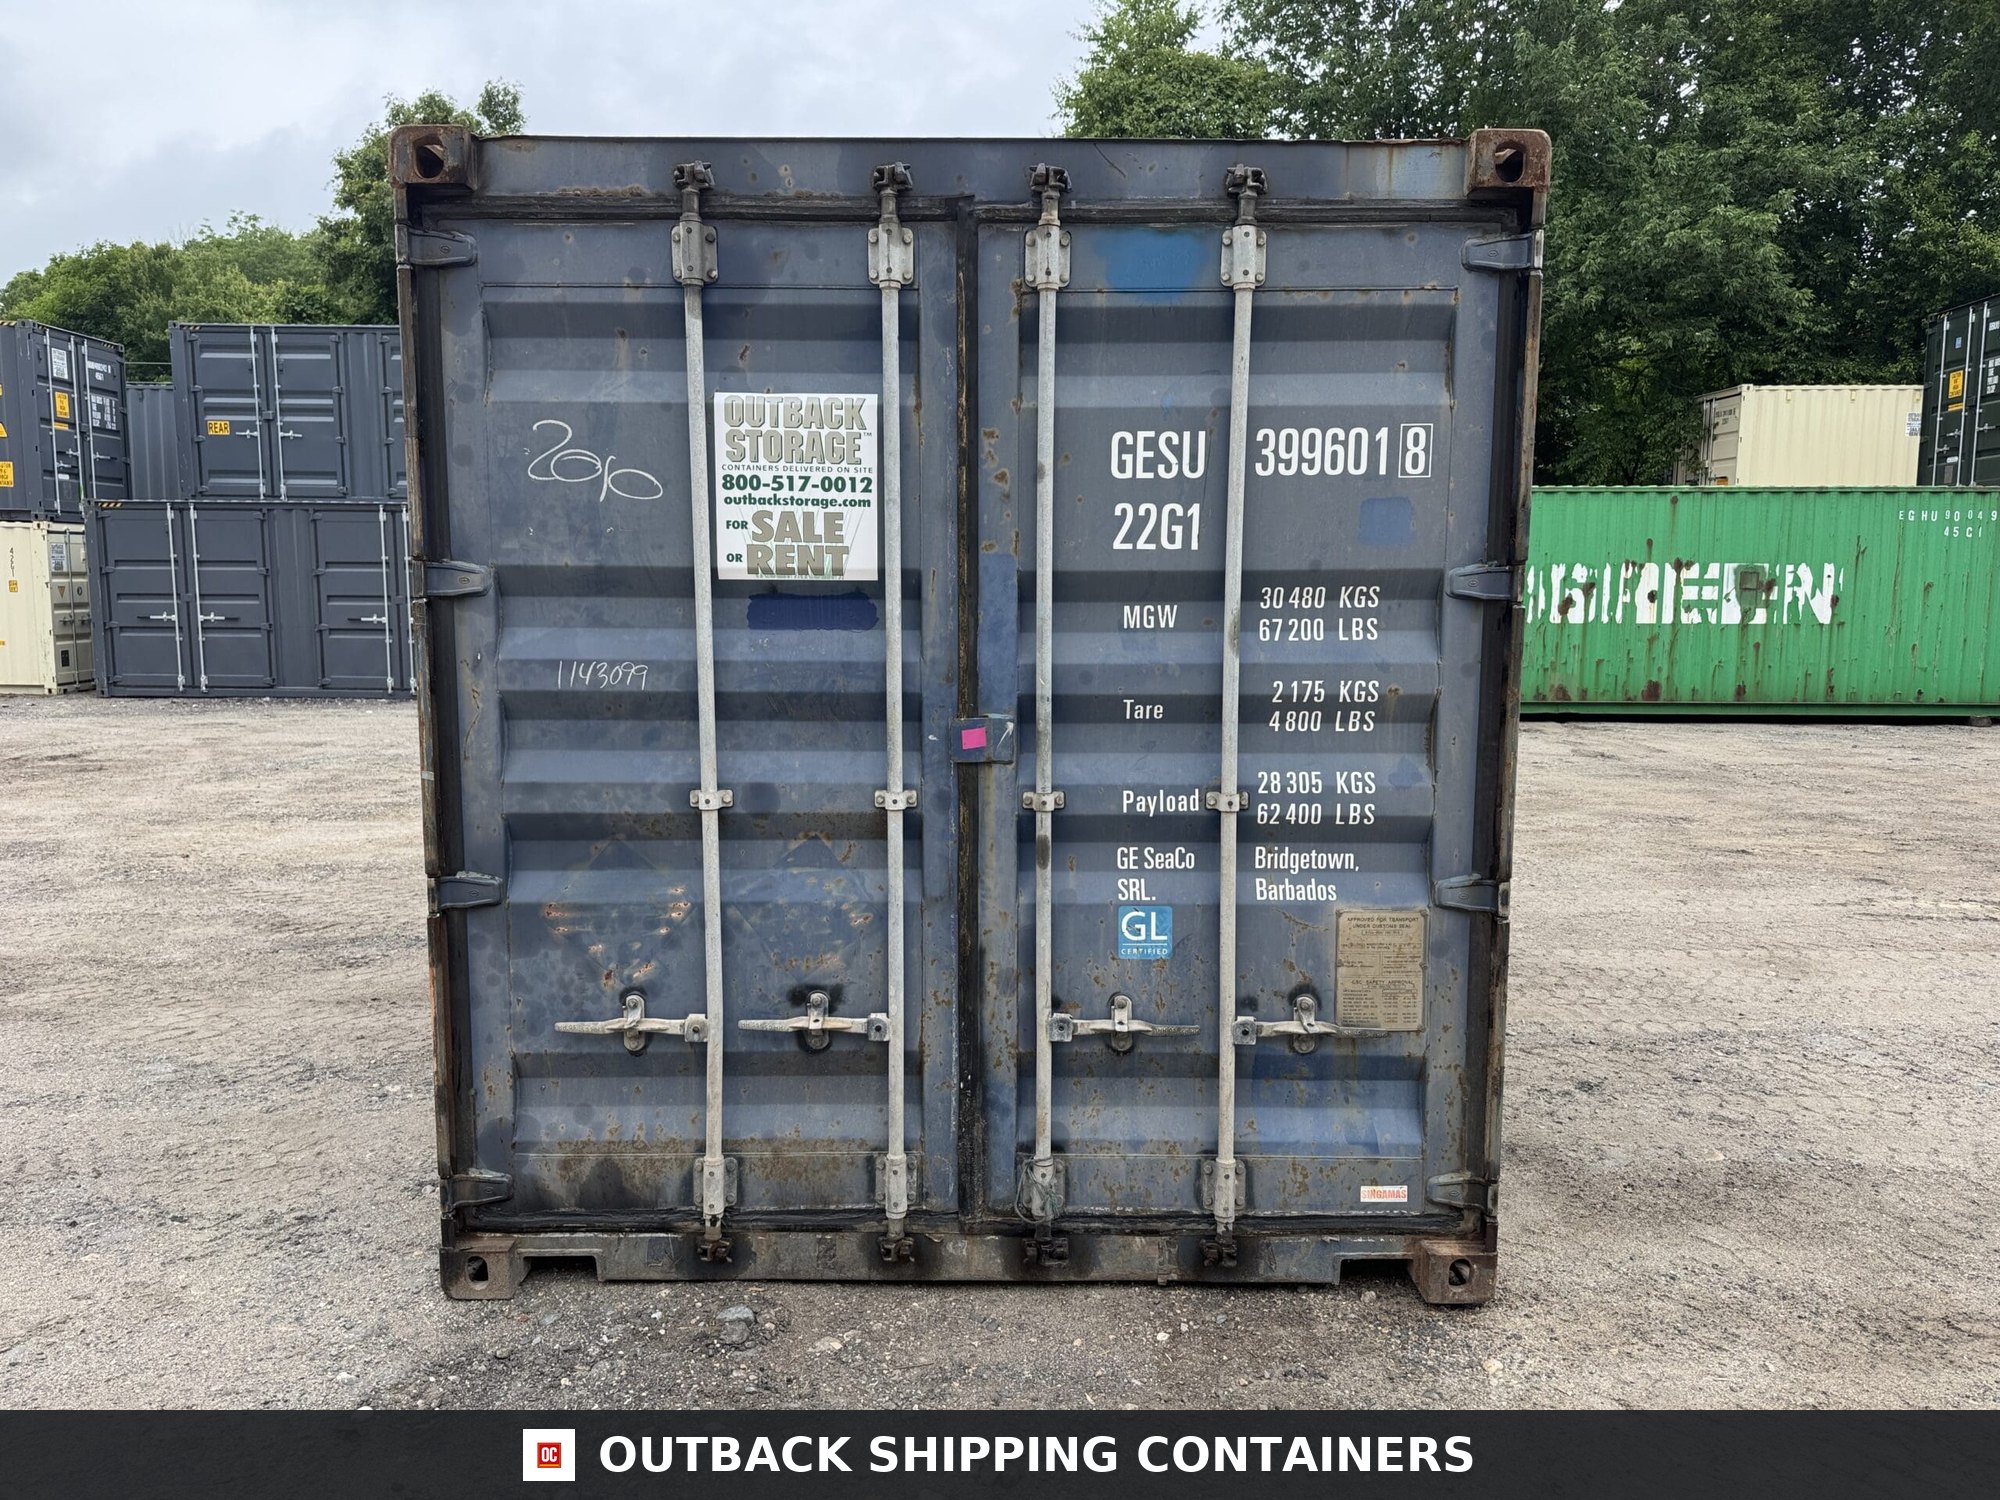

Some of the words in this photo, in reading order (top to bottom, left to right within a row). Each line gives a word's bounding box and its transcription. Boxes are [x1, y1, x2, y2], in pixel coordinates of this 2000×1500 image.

[724, 395, 867, 430] OUTBACK
[209, 422, 228, 433] REAR
[725, 429, 862, 465] STORAGE
[1110, 430, 1206, 479] GESU
[1255, 427, 1389, 477] 399601
[1404, 426, 1427, 475] 8
[722, 464, 780, 472] CONTAINERS
[783, 465, 833, 473] DELIVERED
[854, 466, 873, 474] SITE
[722, 474, 873, 493] 800-517-0012
[724, 493, 871, 509] outbackstorage.com
[726, 520, 748, 530] FOR
[751, 510, 844, 544] SALE
[1112, 503, 1200, 550] 22G1
[1899, 510, 1938, 521] EGHU
[726, 553, 743, 563] OR
[746, 544, 850, 577] RENT
[1339, 585, 1380, 608] KGS
[1123, 604, 1178, 629] MGW
[1338, 618, 1378, 641] LBS
[558, 661, 648, 691] 1143099
[1339, 680, 1380, 703] KGS
[1123, 699, 1164, 719] Tare
[1335, 711, 1376, 732] LBS
[1336, 771, 1376, 794] KGS
[1122, 789, 1200, 816] Payload
[1335, 803, 1376, 825] LBS
[1117, 847, 1139, 870] GE
[1144, 847, 1195, 870] SeaCo
[1254, 846, 1360, 875] Bridgetown,
[1118, 879, 1156, 901] SRL.
[1255, 878, 1337, 901] Barbados
[1121, 911, 1168, 940] GL
[1361, 1189, 1407, 1199] SINGAMAS
